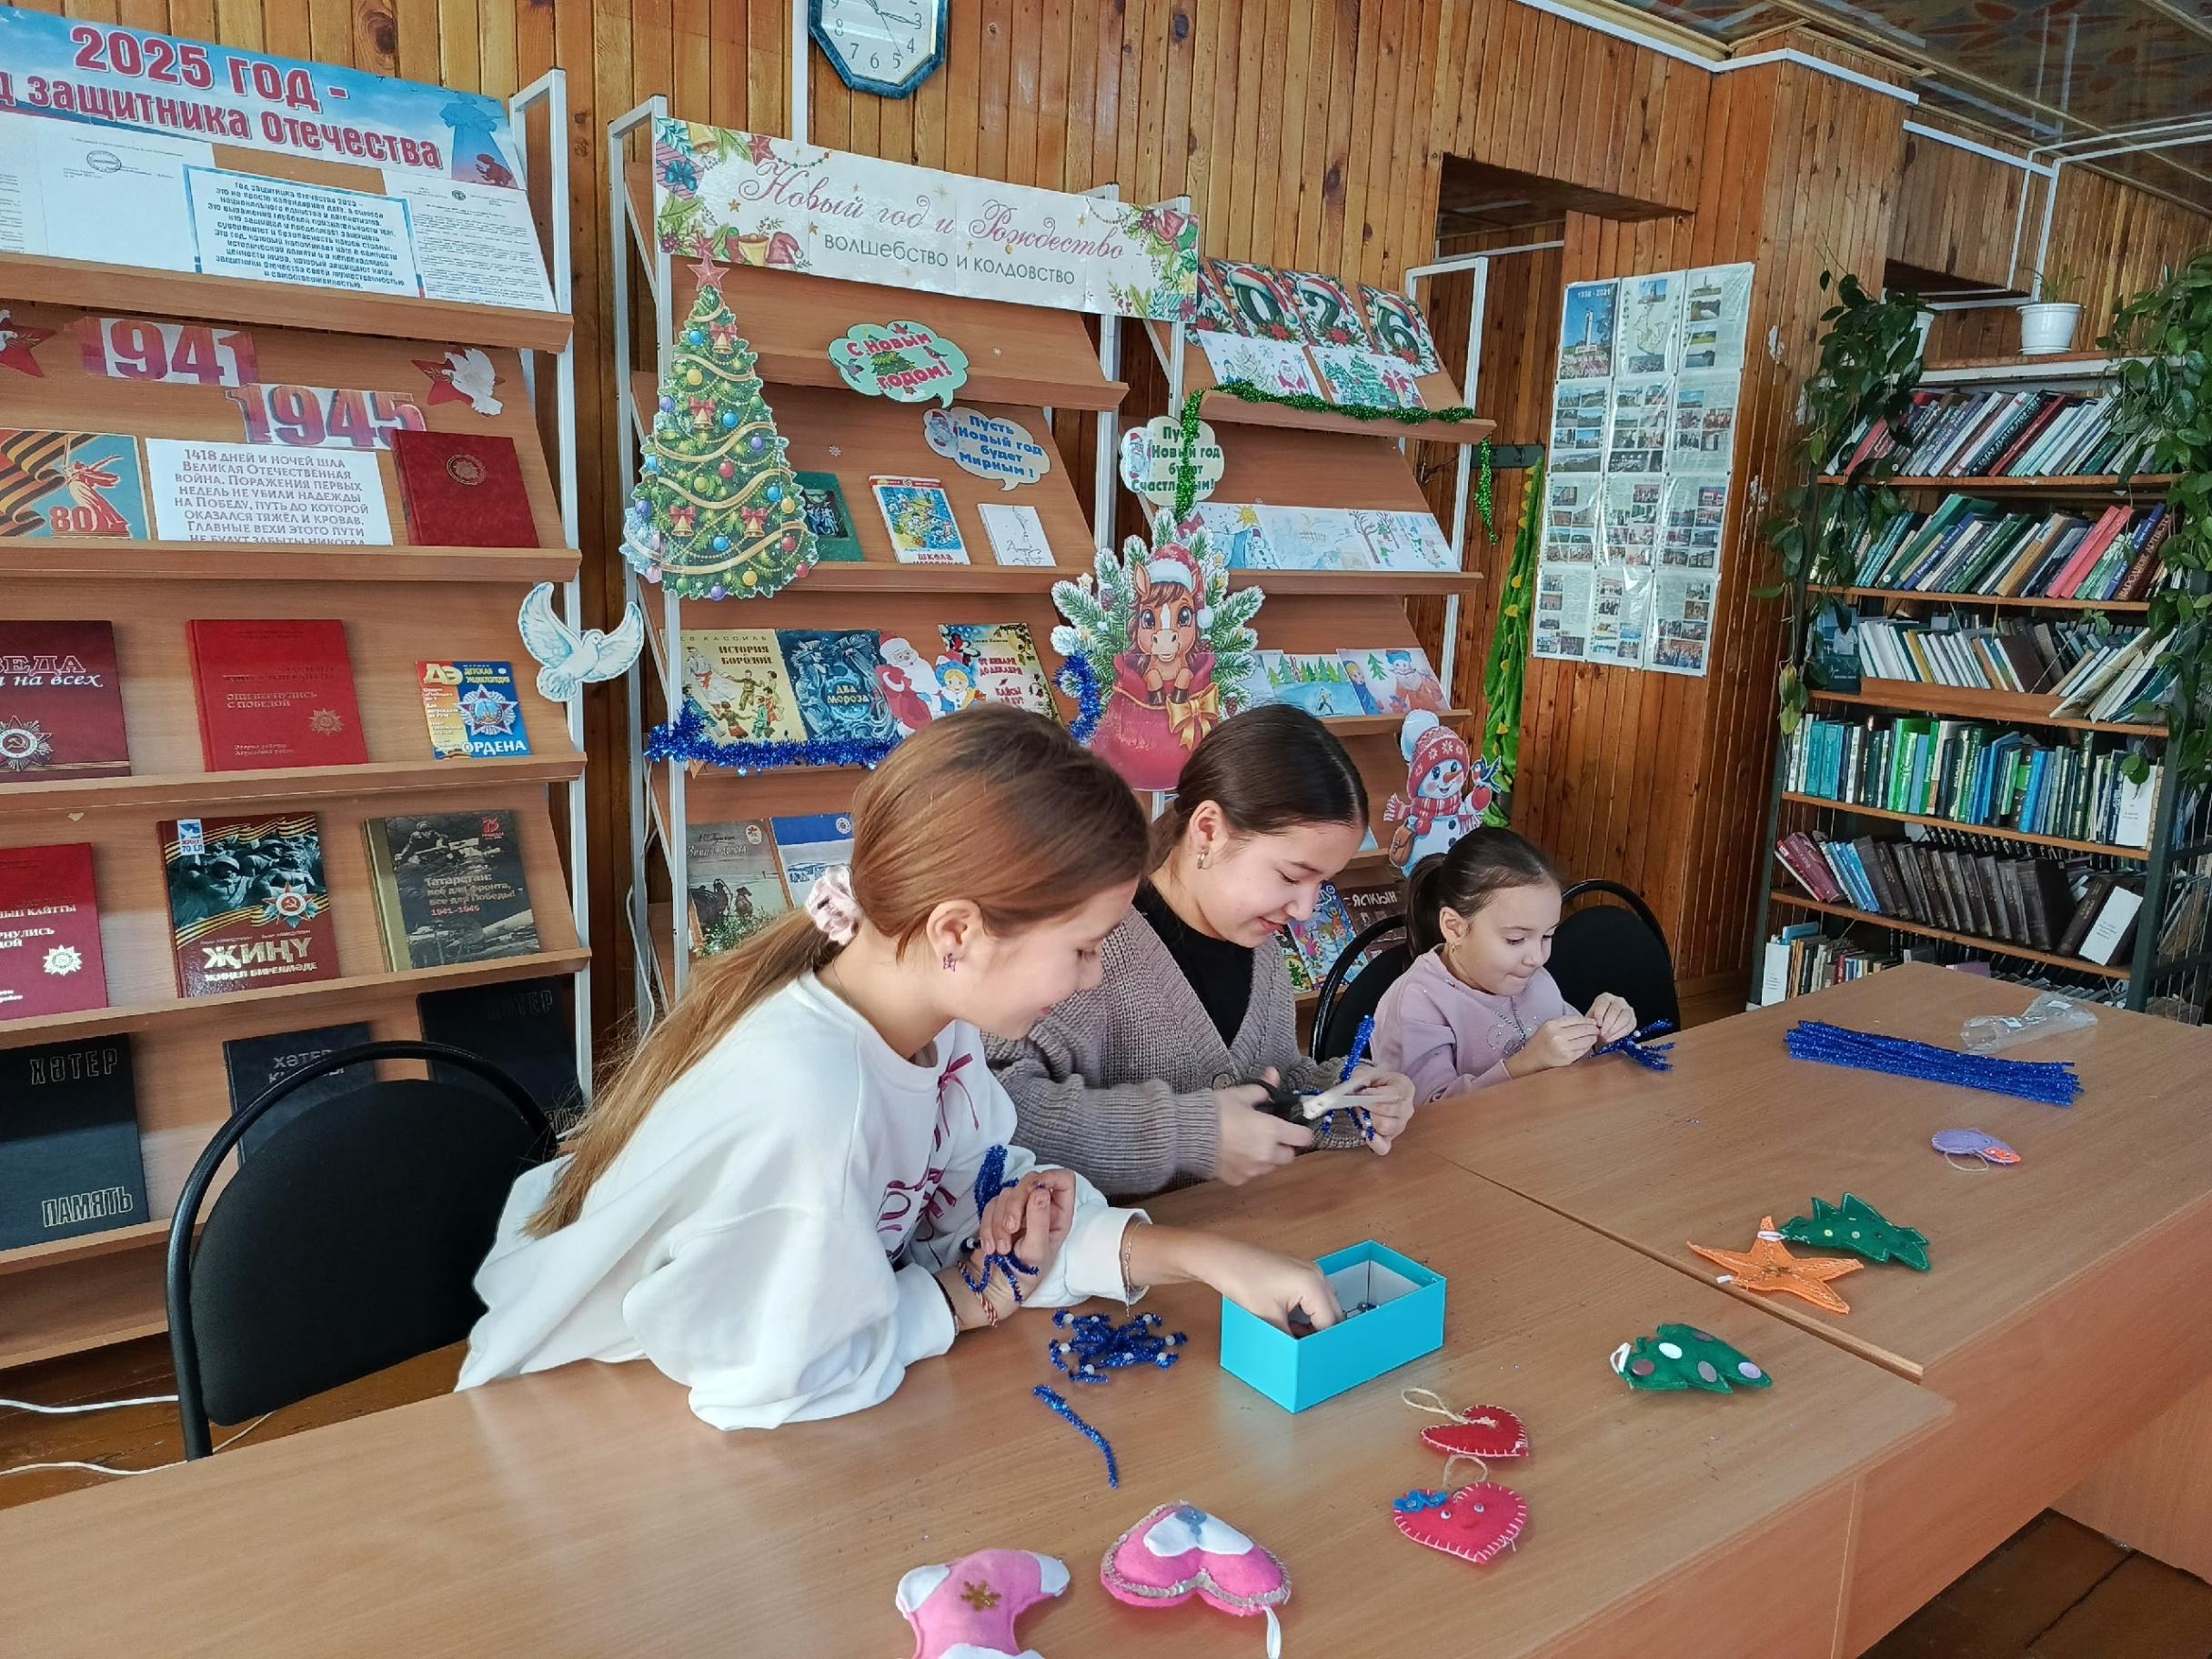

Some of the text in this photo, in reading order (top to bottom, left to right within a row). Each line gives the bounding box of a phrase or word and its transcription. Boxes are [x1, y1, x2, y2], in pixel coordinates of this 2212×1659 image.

[834, 18, 844, 36] 8
[914, 13, 922, 29] 3
[850, 43, 860, 59] 7
[906, 37, 915, 54] 4
[71, 25, 214, 89] 2025
[327, 85, 349, 99] -
[870, 52, 880, 69] 6
[892, 53, 902, 69] 5
[27, 75, 251, 138] защитника
[739, 161, 1124, 259] Новый год и Рождество
[1377, 304, 1420, 356] 6
[64, 316, 259, 387] 1941
[847, 342, 864, 357] С
[226, 382, 427, 447] 1945
[969, 416, 1014, 435] Пусть
[958, 426, 1043, 457] Новый год
[185, 448, 346, 468] 1418 ДНЕЙ И НОЧЕЙ ШЛА
[980, 445, 1022, 462] будет
[1201, 447, 1221, 458] год
[959, 451, 1025, 477] Мирным
[175, 473, 225, 484] ВОЙНА.
[313, 480, 362, 491] ПЕРВЫХ
[178, 486, 361, 503] НЕДЕЛЬ НЕ УБИЛИ НАДЕЖДЫ
[175, 497, 193, 507] НА
[256, 500, 287, 511] ПУТЬ
[290, 503, 307, 512] ДО
[310, 503, 369, 514] КОТОРОЙ
[49, 506, 94, 532] 80
[184, 509, 253, 521] ОКАЗАЛСЯ
[301, 515, 311, 523] И
[314, 515, 364, 526] КРОВАВ.
[254, 524, 286, 534] ВЕХИ
[289, 526, 328, 535] ЭТОГО
[332, 527, 365, 537] ПУТИ
[719, 646, 769, 654] ИСТОРИЯ
[721, 657, 772, 665] БОРОДОЙ
[14, 672, 104, 688] на всех
[423, 663, 464, 686] ДЭ
[836, 684, 857, 694] ДВА
[827, 694, 870, 705] МОРОЗА
[461, 740, 528, 756] ОРДЕНА
[29, 1047, 119, 1086] ХӘТЕР
[41, 1185, 134, 1229] ПАМЯТЬ
